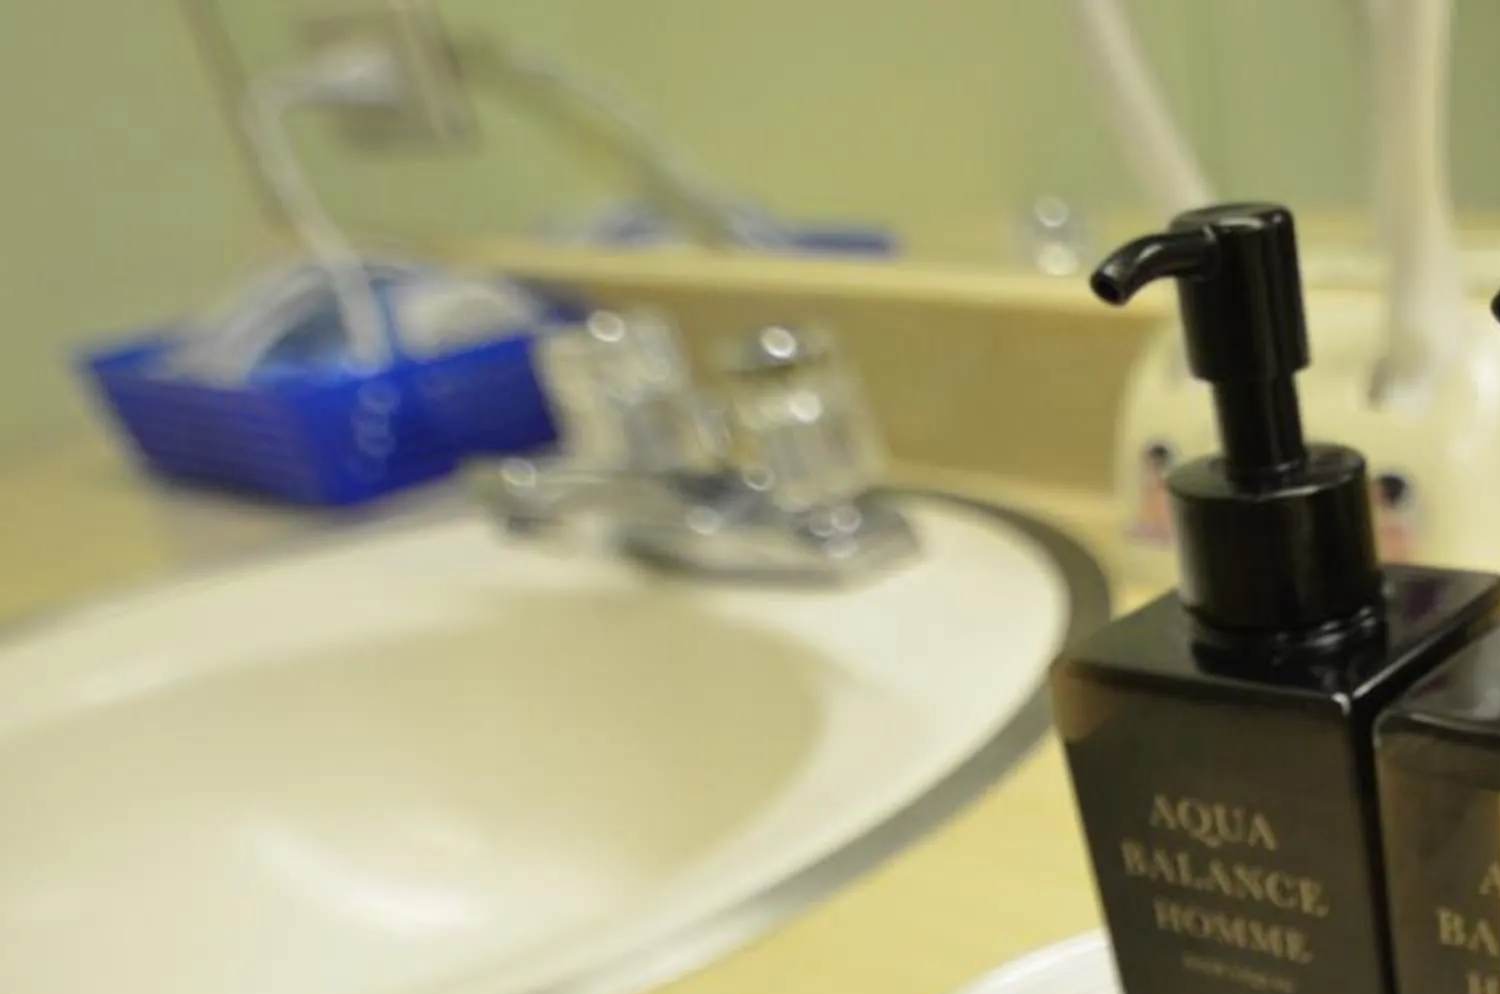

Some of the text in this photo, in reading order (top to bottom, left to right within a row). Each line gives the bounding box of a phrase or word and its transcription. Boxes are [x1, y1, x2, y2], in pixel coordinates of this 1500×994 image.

[1150, 795, 1276, 850] AQUA
[1121, 837, 1330, 918] BALANCE
[1153, 896, 1314, 963] HOMME
